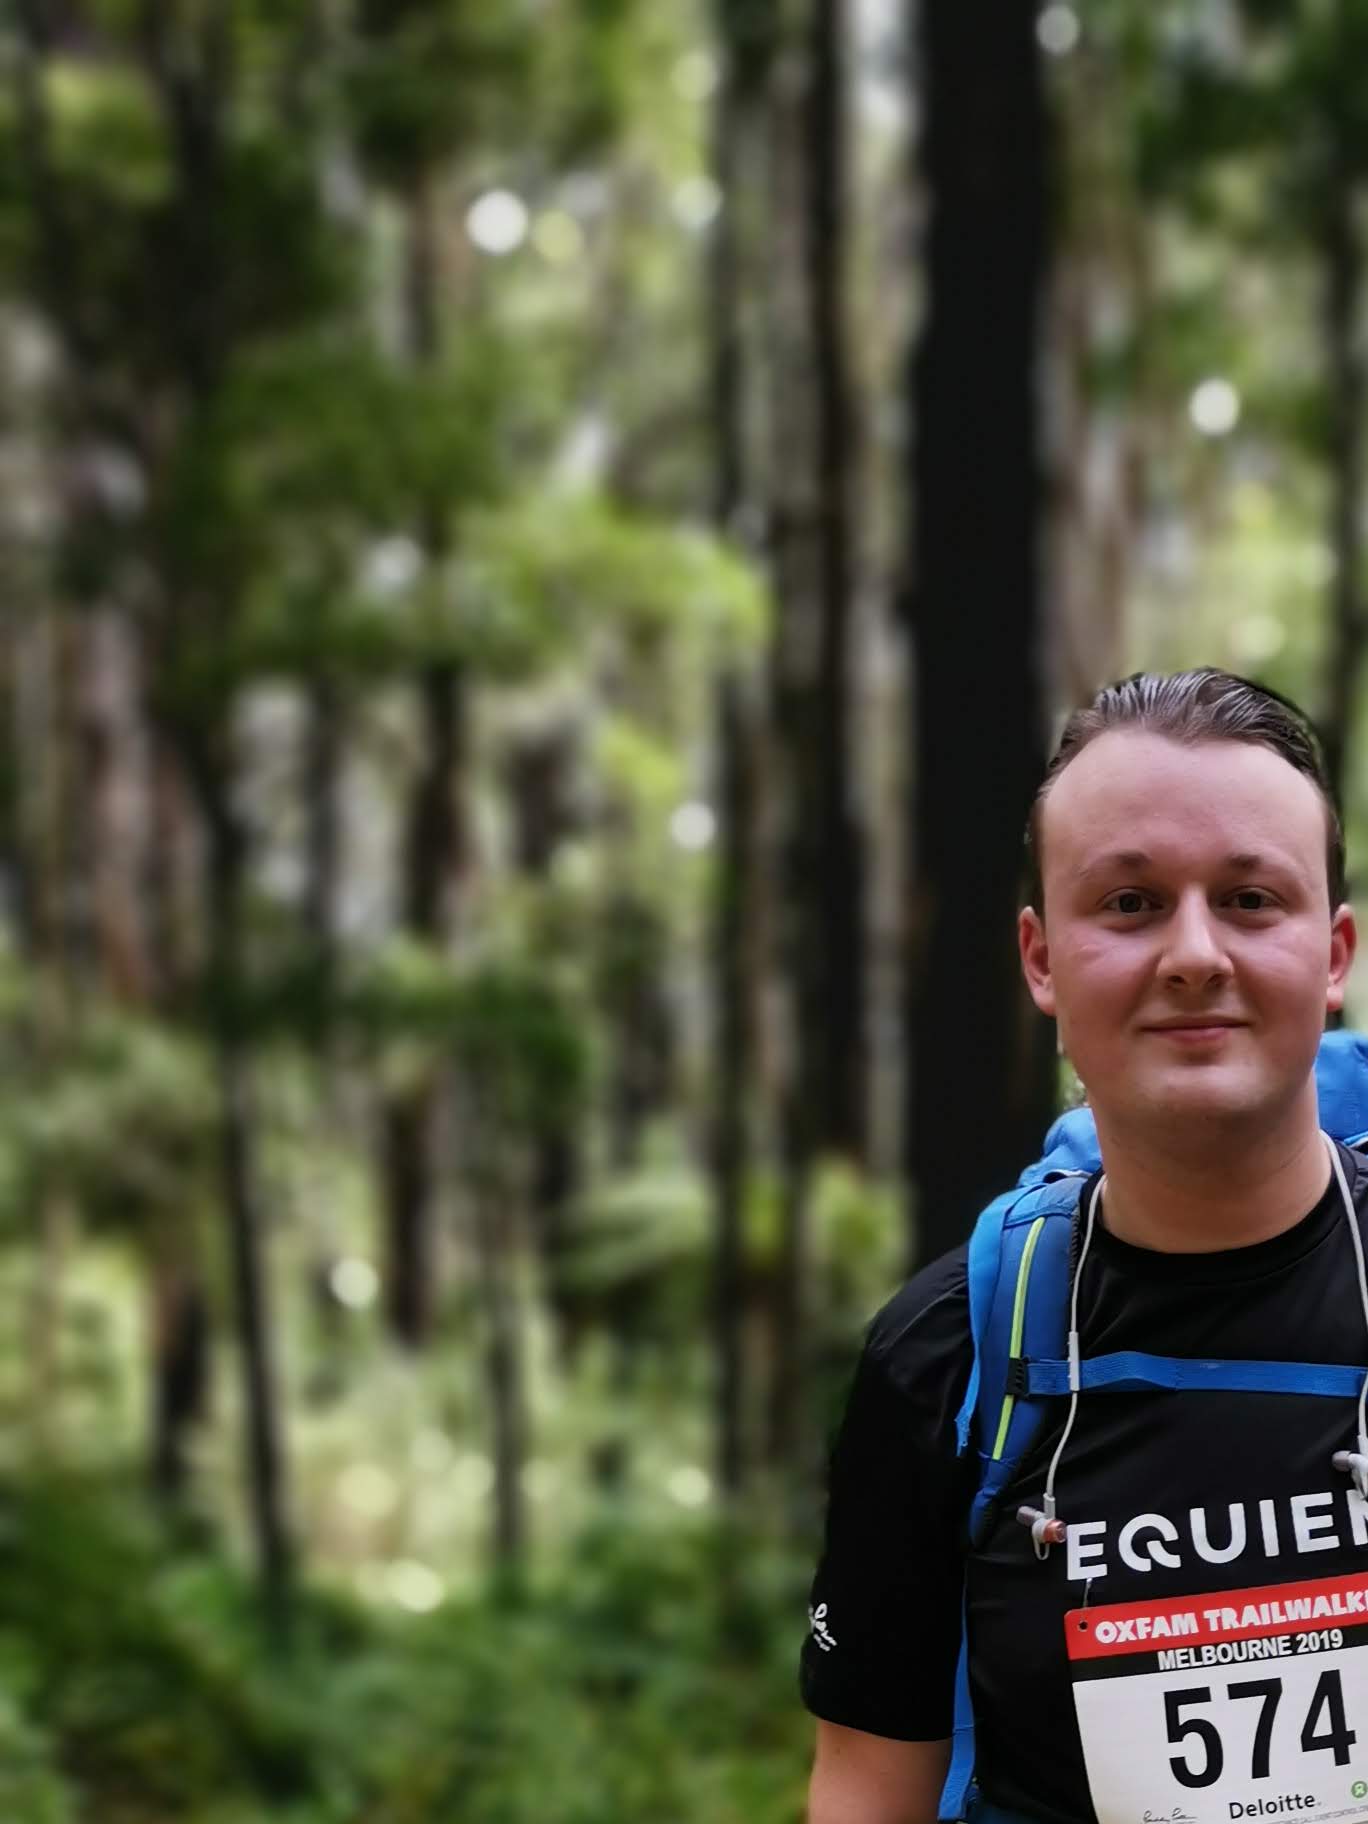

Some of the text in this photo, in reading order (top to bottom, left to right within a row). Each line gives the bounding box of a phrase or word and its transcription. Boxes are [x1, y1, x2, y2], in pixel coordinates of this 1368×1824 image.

[1095, 1612, 1199, 1644] OXFAM
[1158, 1628, 1344, 1671] MELBOURNE 2019
[1163, 1669, 1357, 1789] 574
